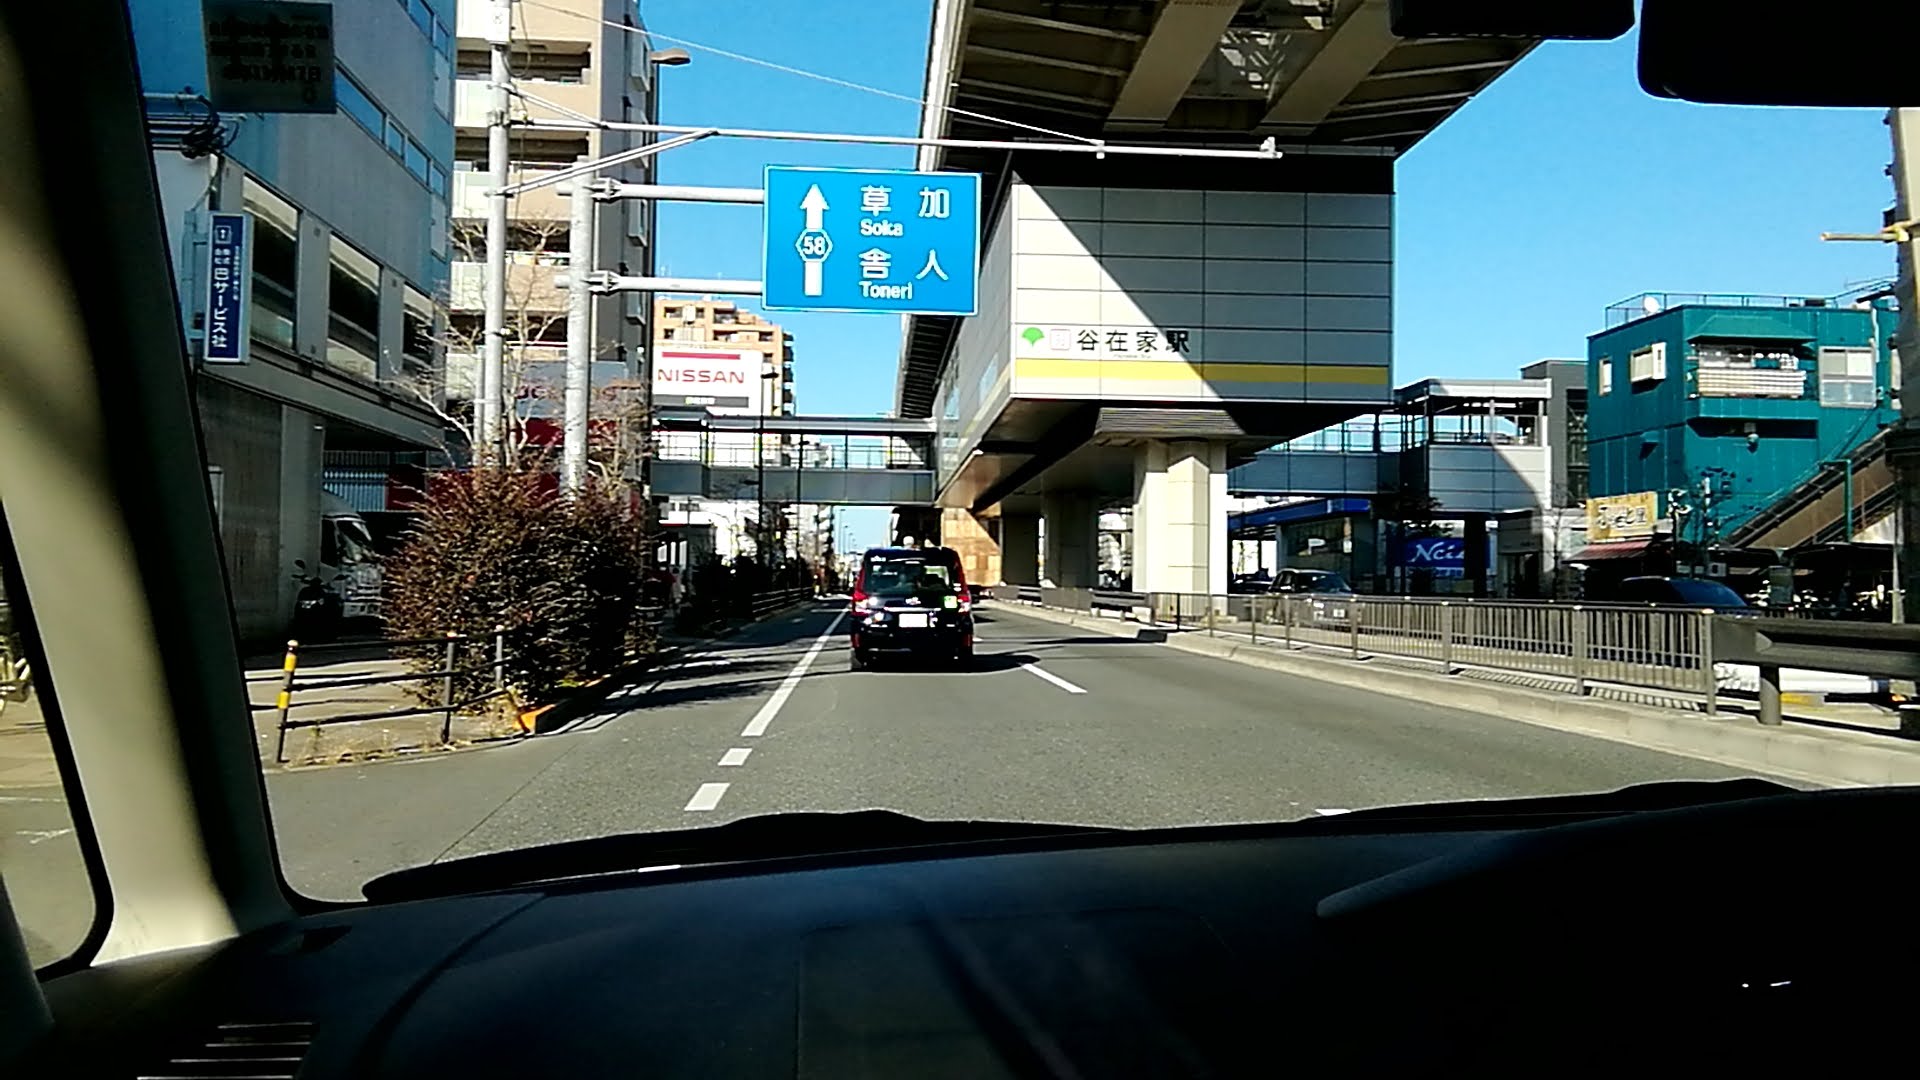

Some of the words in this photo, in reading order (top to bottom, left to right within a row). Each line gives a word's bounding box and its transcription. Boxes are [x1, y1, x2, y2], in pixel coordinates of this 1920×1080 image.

[860, 184, 950, 219] 草加
[860, 219, 904, 237] Soka
[802, 236, 826, 255] 58
[858, 247, 949, 281] 舎人
[858, 281, 913, 300] Toneri
[1076, 329, 1191, 353] 谷在家駅
[657, 369, 745, 384] NISSAN
